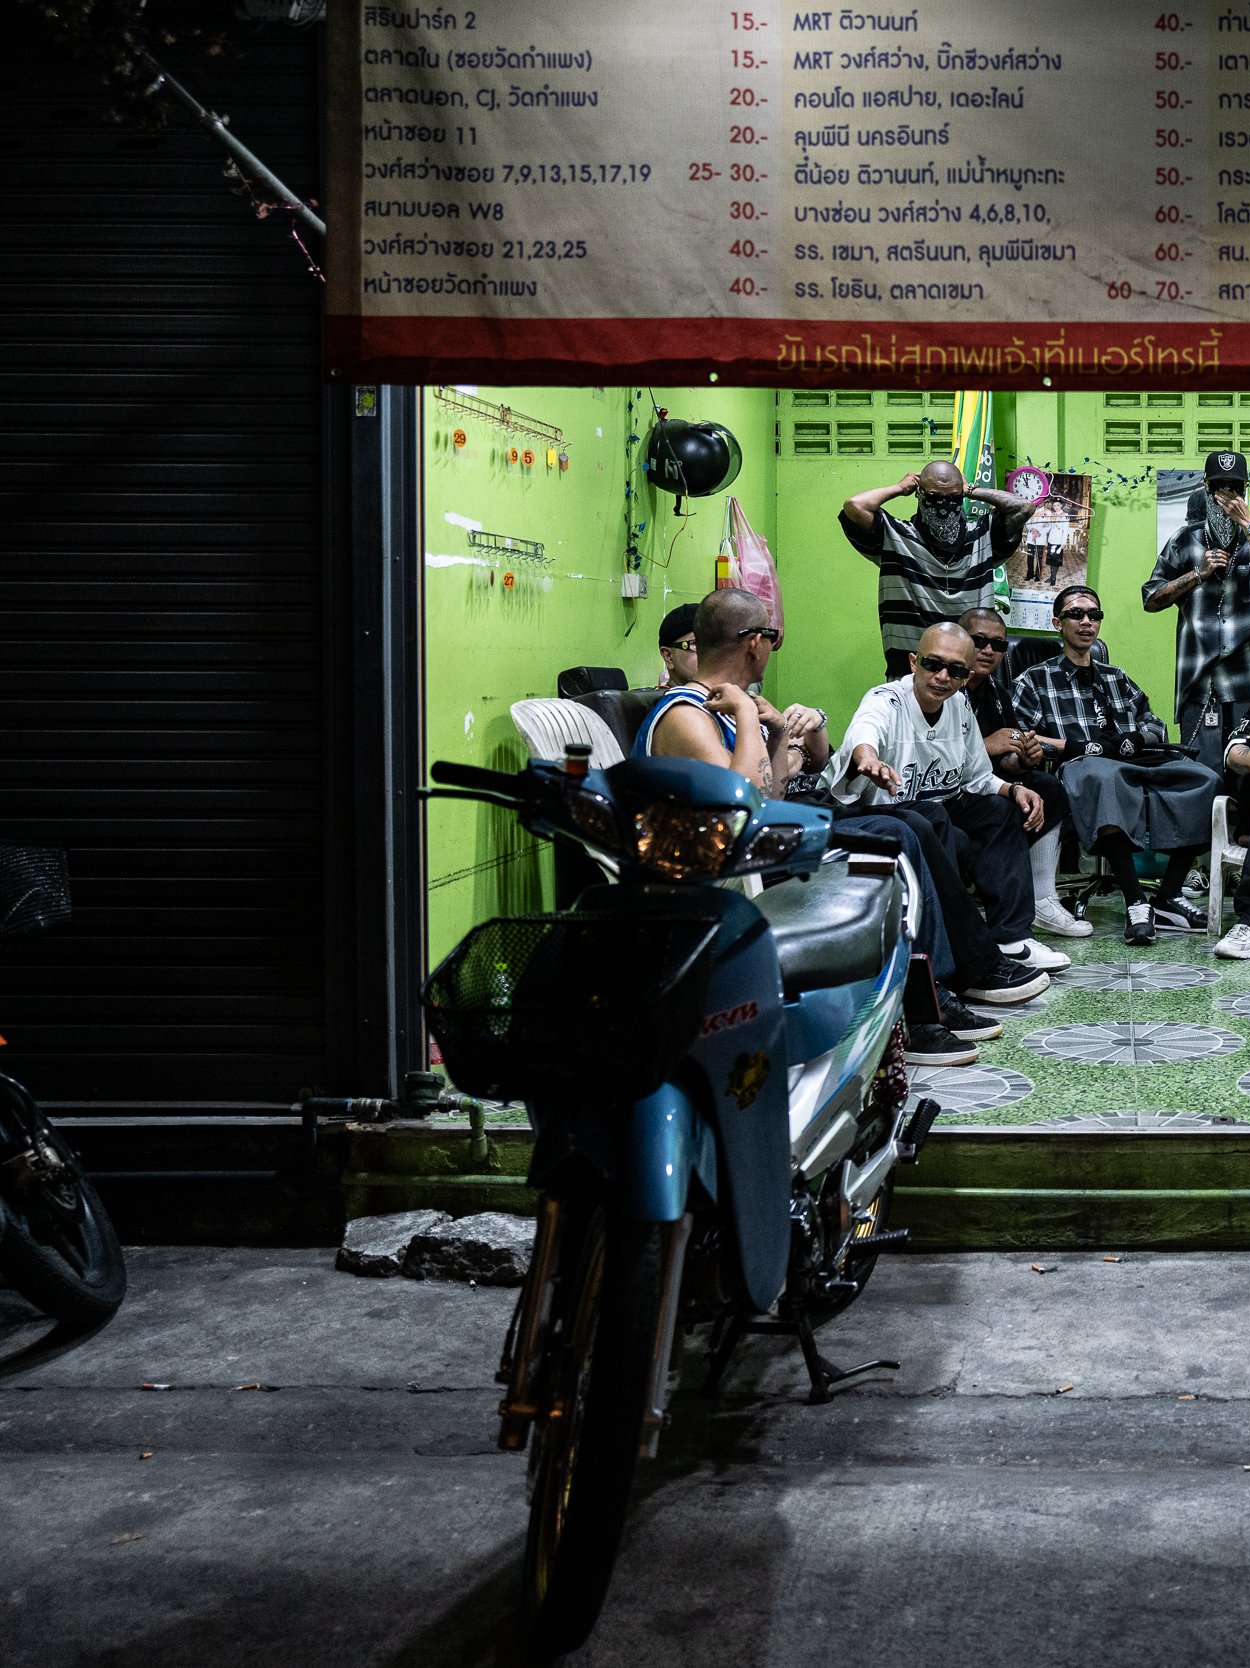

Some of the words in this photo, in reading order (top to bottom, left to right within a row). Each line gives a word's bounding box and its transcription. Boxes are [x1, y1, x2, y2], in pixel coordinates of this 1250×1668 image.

[365, 4, 455, 33] สิรินปาร์ค
[465, 11, 475, 29] 2
[731, 12, 767, 30] 15.-
[794, 12, 832, 30] MRT
[840, 9, 918, 31] ติวานนท์
[1155, 13, 1192, 31] 40.-
[365, 43, 442, 71] ตลาดใน
[447, 46, 596, 72] (ซอยวัดกำแพง)
[732, 50, 767, 68] 15.-
[794, 51, 833, 69] MRT
[841, 46, 929, 71] วงศ์สว่าง,
[938, 43, 1062, 70] บิ๊กซีวงศ์สว่าง
[1156, 52, 1192, 70] 50.-
[365, 85, 468, 106] ตลาดนอก,
[476, 88, 500, 111] CJ,
[509, 84, 597, 107] วัดกำแพง
[730, 88, 767, 106] 20.-
[795, 86, 854, 108] คอนโด
[863, 85, 942, 109] แอสปาย,
[951, 86, 1023, 109] เดอะไลน์
[1156, 90, 1192, 109] 50.-
[365, 119, 446, 144] หน้าซอย
[456, 127, 476, 145] 11
[730, 125, 767, 144] 20.-
[795, 124, 849, 153] ลุมพีนี
[858, 122, 950, 146] นครอินทร์
[1156, 129, 1192, 147] 50.-
[365, 154, 497, 182] วงศ์สว่างซอย
[502, 164, 650, 185] 7,9,13,15,17,19
[689, 163, 721, 181] 25-
[730, 163, 767, 182] 30.-
[858, 161, 939, 186] ติวานนท์,
[948, 155, 1064, 191] แม่น้ำหมูกะทะ
[1156, 167, 1192, 185] 50.-
[365, 201, 460, 219] สนามบอล
[468, 202, 503, 220] W8
[730, 201, 767, 220] 30.-
[795, 200, 870, 223] บางซ่อน
[879, 199, 961, 223] วงศ์สว่าง
[970, 204, 1051, 224] 4,6,8,10,
[1155, 205, 1192, 223] 60.-
[364, 233, 493, 258] วงศ์สว่างซอย
[502, 240, 587, 260] 21,23,25
[730, 240, 767, 258] 40.-
[795, 244, 823, 260] รร.
[833, 245, 879, 263] เขมา,
[887, 239, 970, 262] สตรีนนท,
[979, 238, 1076, 267] ลุมพีนีเขมา
[1155, 243, 1192, 261] 60.-
[1219, 245, 1249, 261] สน.
[364, 268, 541, 296] หน้าซอยวัดกำแพง
[729, 278, 768, 295] 40.-
[795, 282, 824, 298] รร.
[831, 277, 882, 301] โยธิน,
[890, 284, 984, 300] ตลาดเขมา
[454, 433, 466, 445] 29
[525, 452, 532, 464] 5
[504, 576, 514, 586] 27
